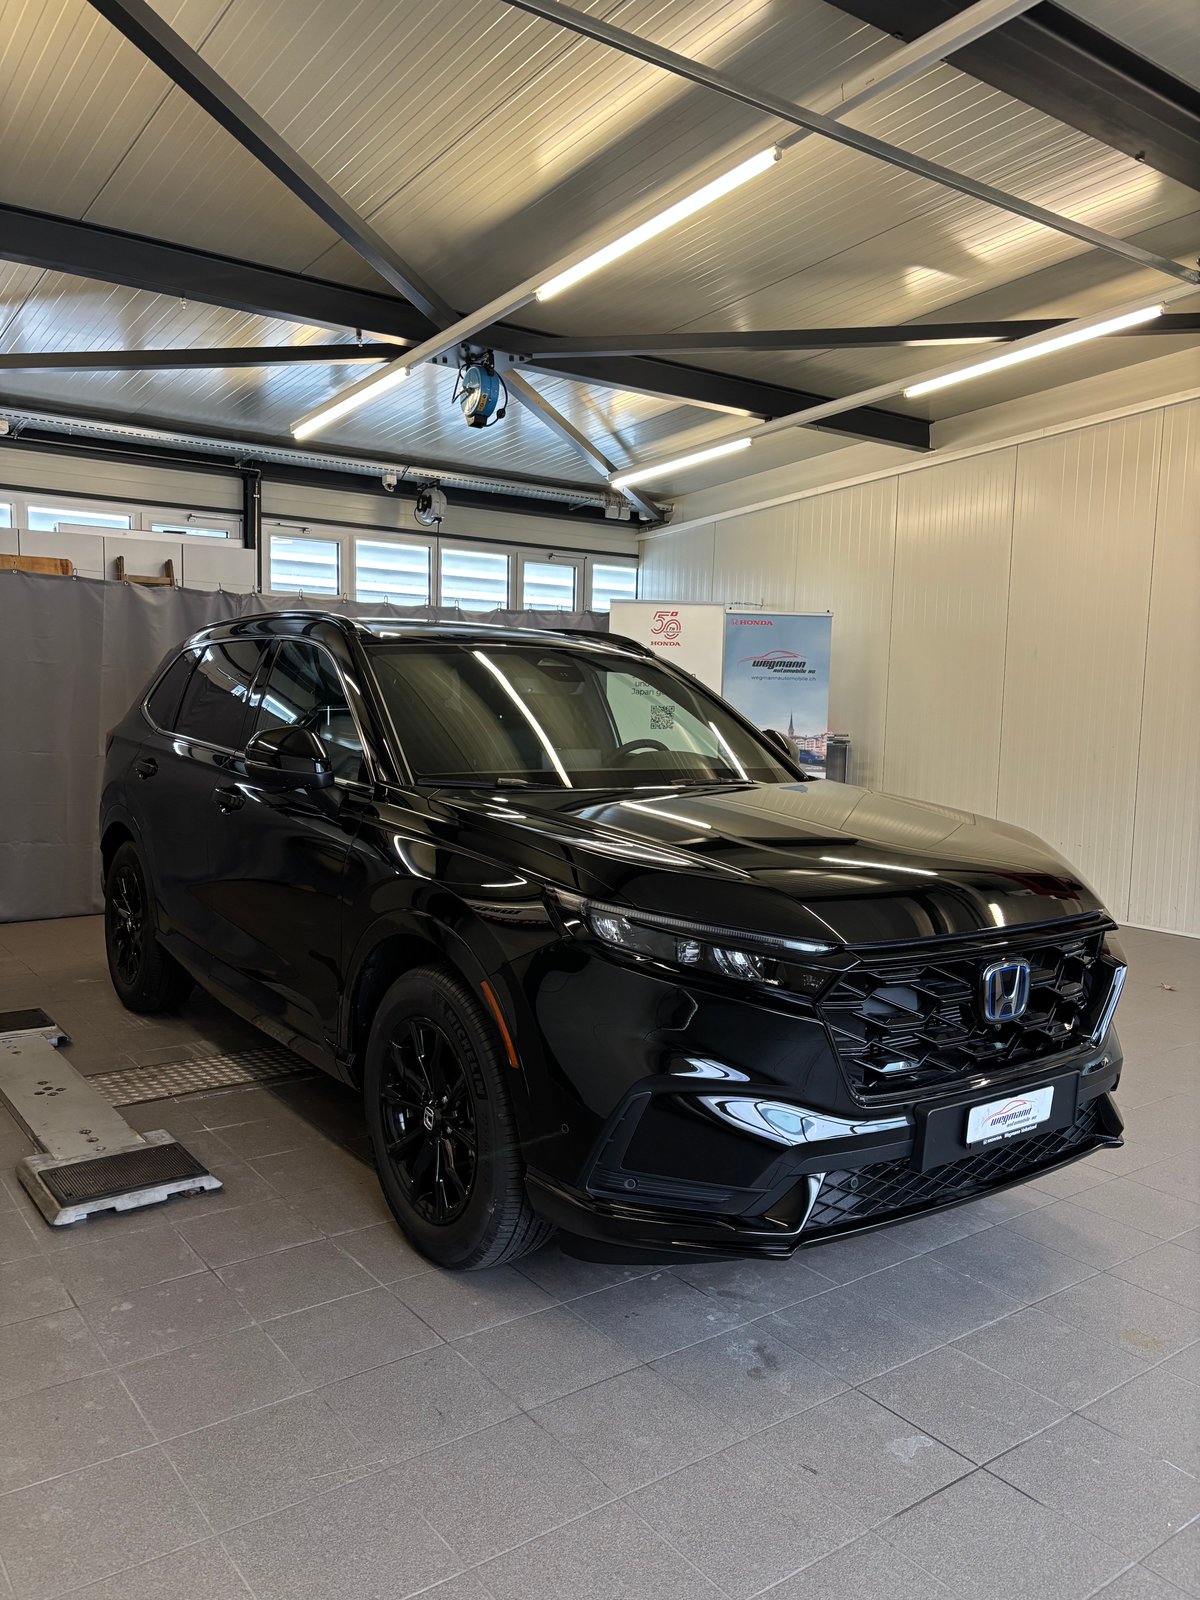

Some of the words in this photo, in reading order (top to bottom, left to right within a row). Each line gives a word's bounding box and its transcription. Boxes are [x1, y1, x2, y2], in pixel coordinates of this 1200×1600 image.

[752, 660, 806, 669] wegmann
[631, 688, 654, 697] Japan
[446, 1008, 486, 1096] MICHELIN
